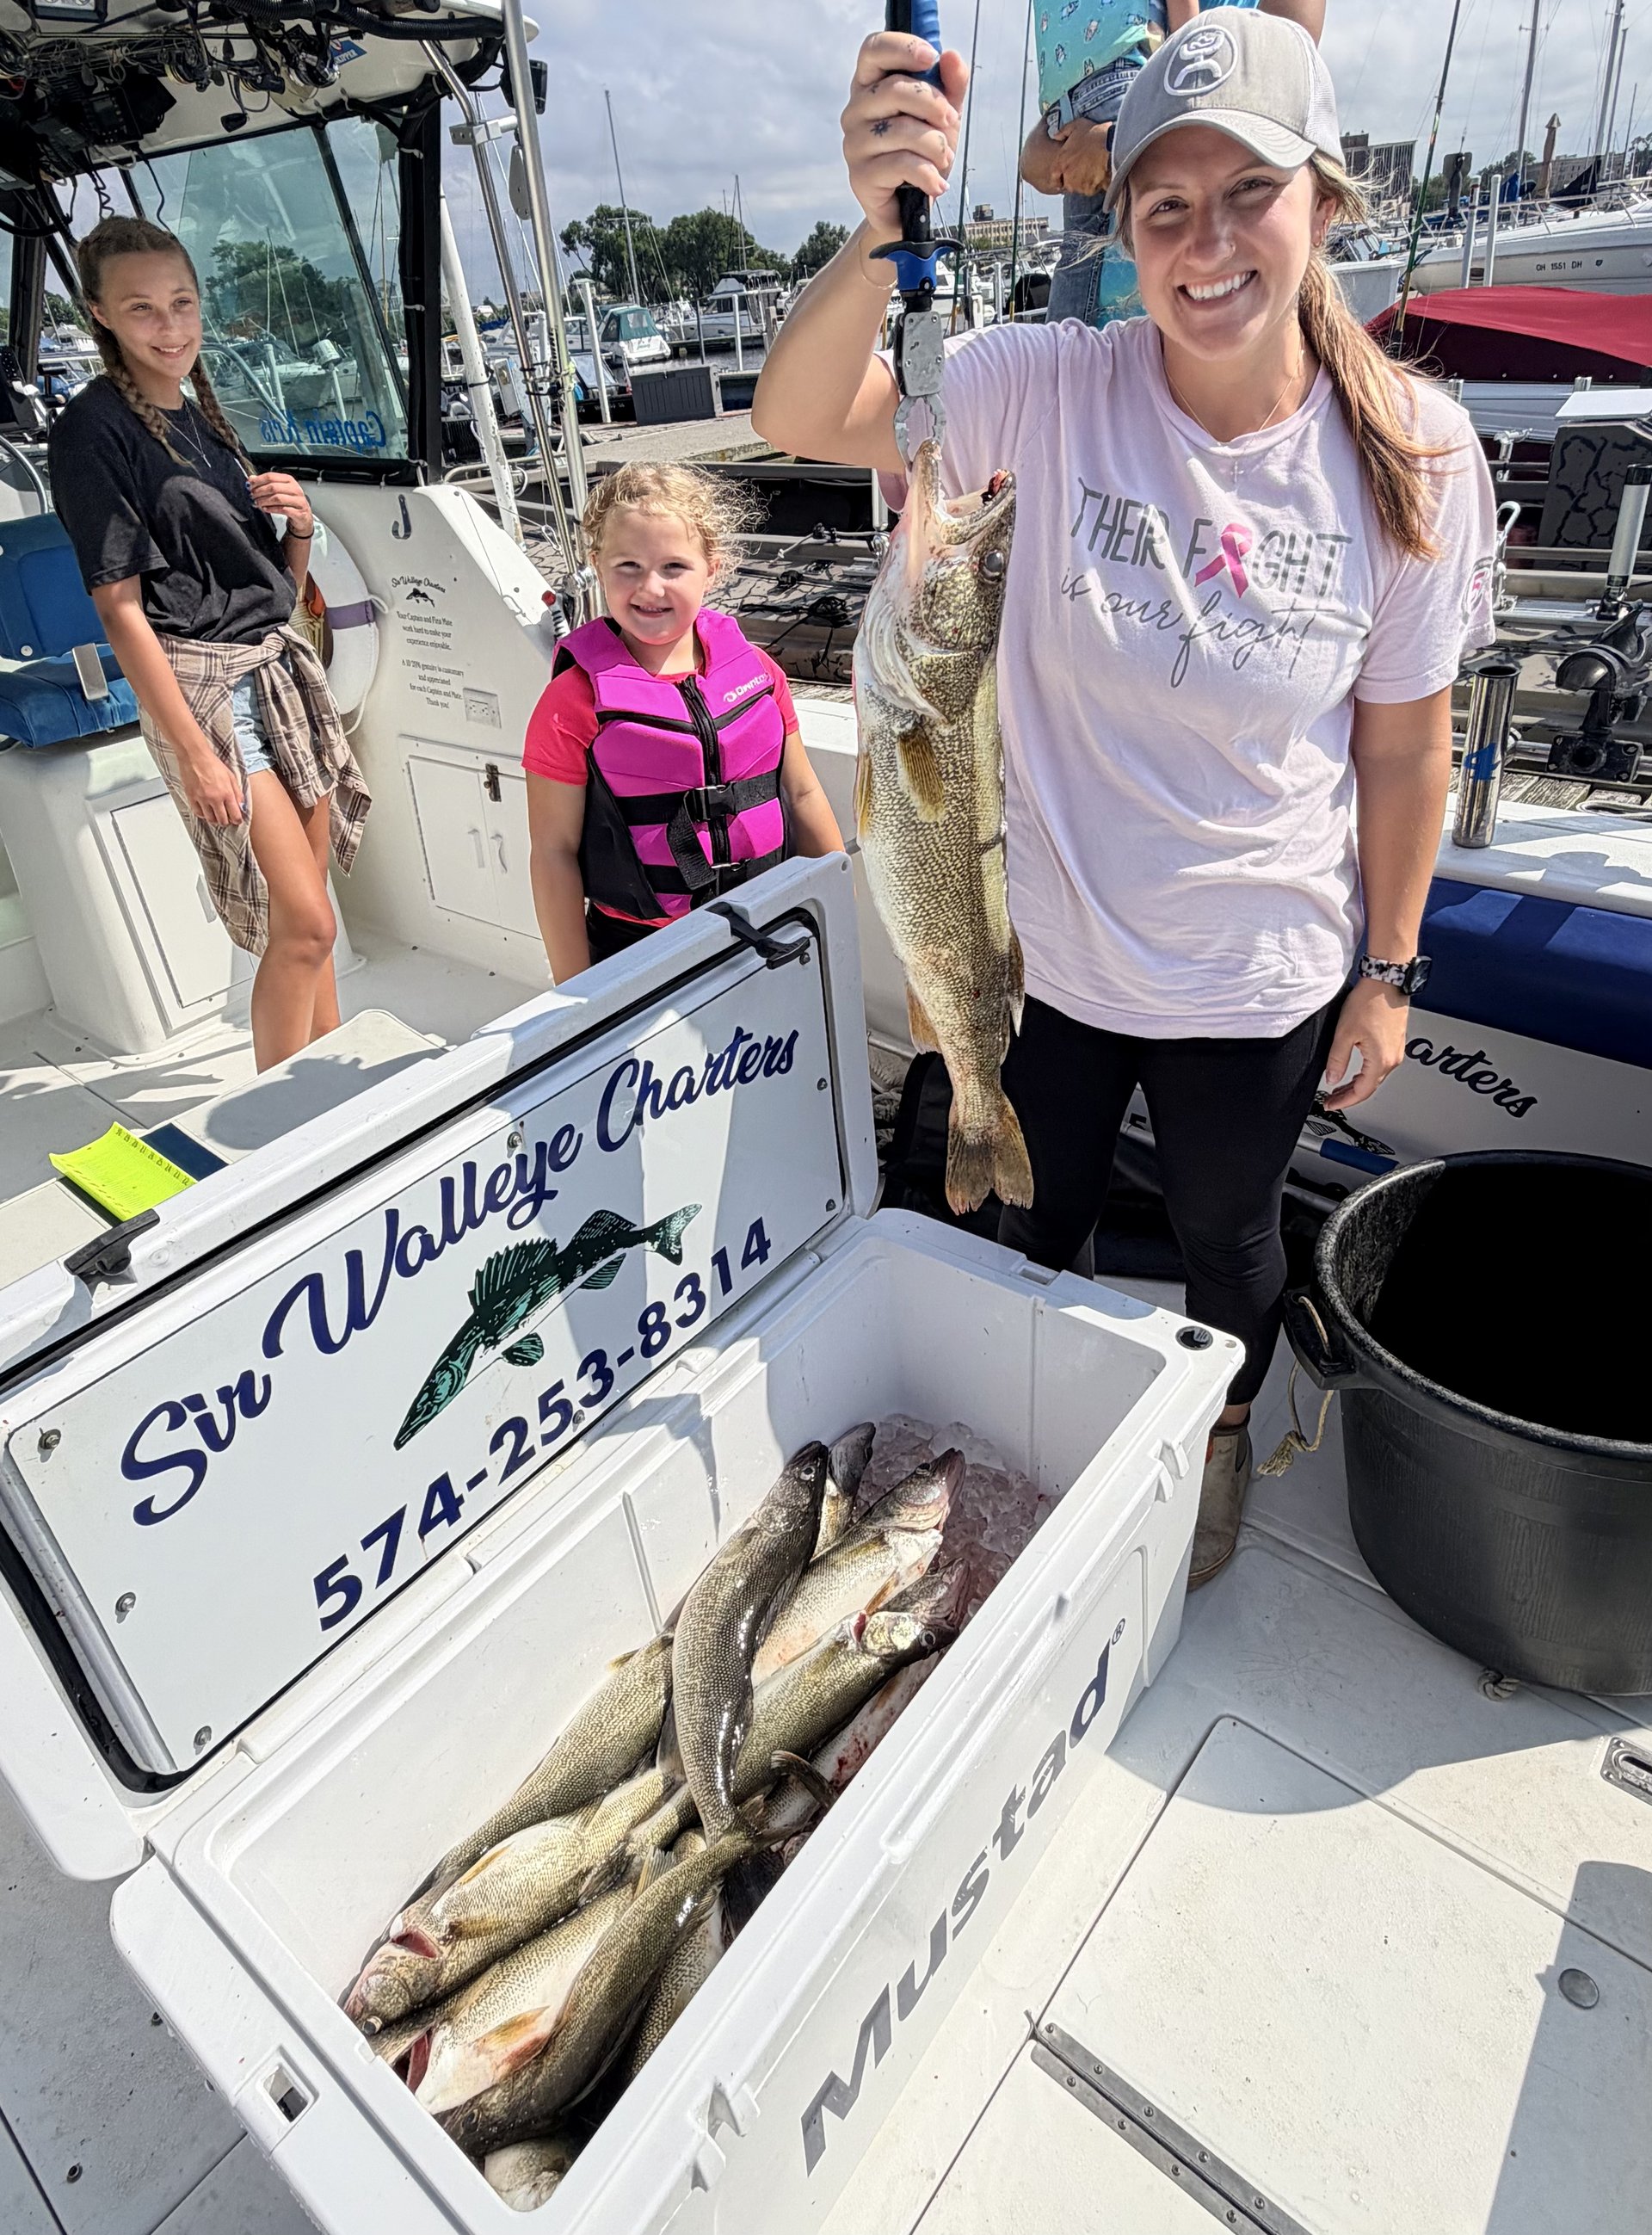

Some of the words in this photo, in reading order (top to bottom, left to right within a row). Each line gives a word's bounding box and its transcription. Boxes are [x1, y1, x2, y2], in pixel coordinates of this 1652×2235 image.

[1061, 567, 1092, 602] is
[1100, 592, 1184, 630] our
[1070, 477, 1170, 571] THEIR
[1404, 1037, 1538, 1119] arters
[120, 1368, 274, 1527] Sir
[261, 1123, 584, 1360] Walleye
[595, 1026, 799, 1152] Charters
[311, 1217, 773, 1632] 574-253-8314
[800, 1638, 1111, 2178] Mustad
